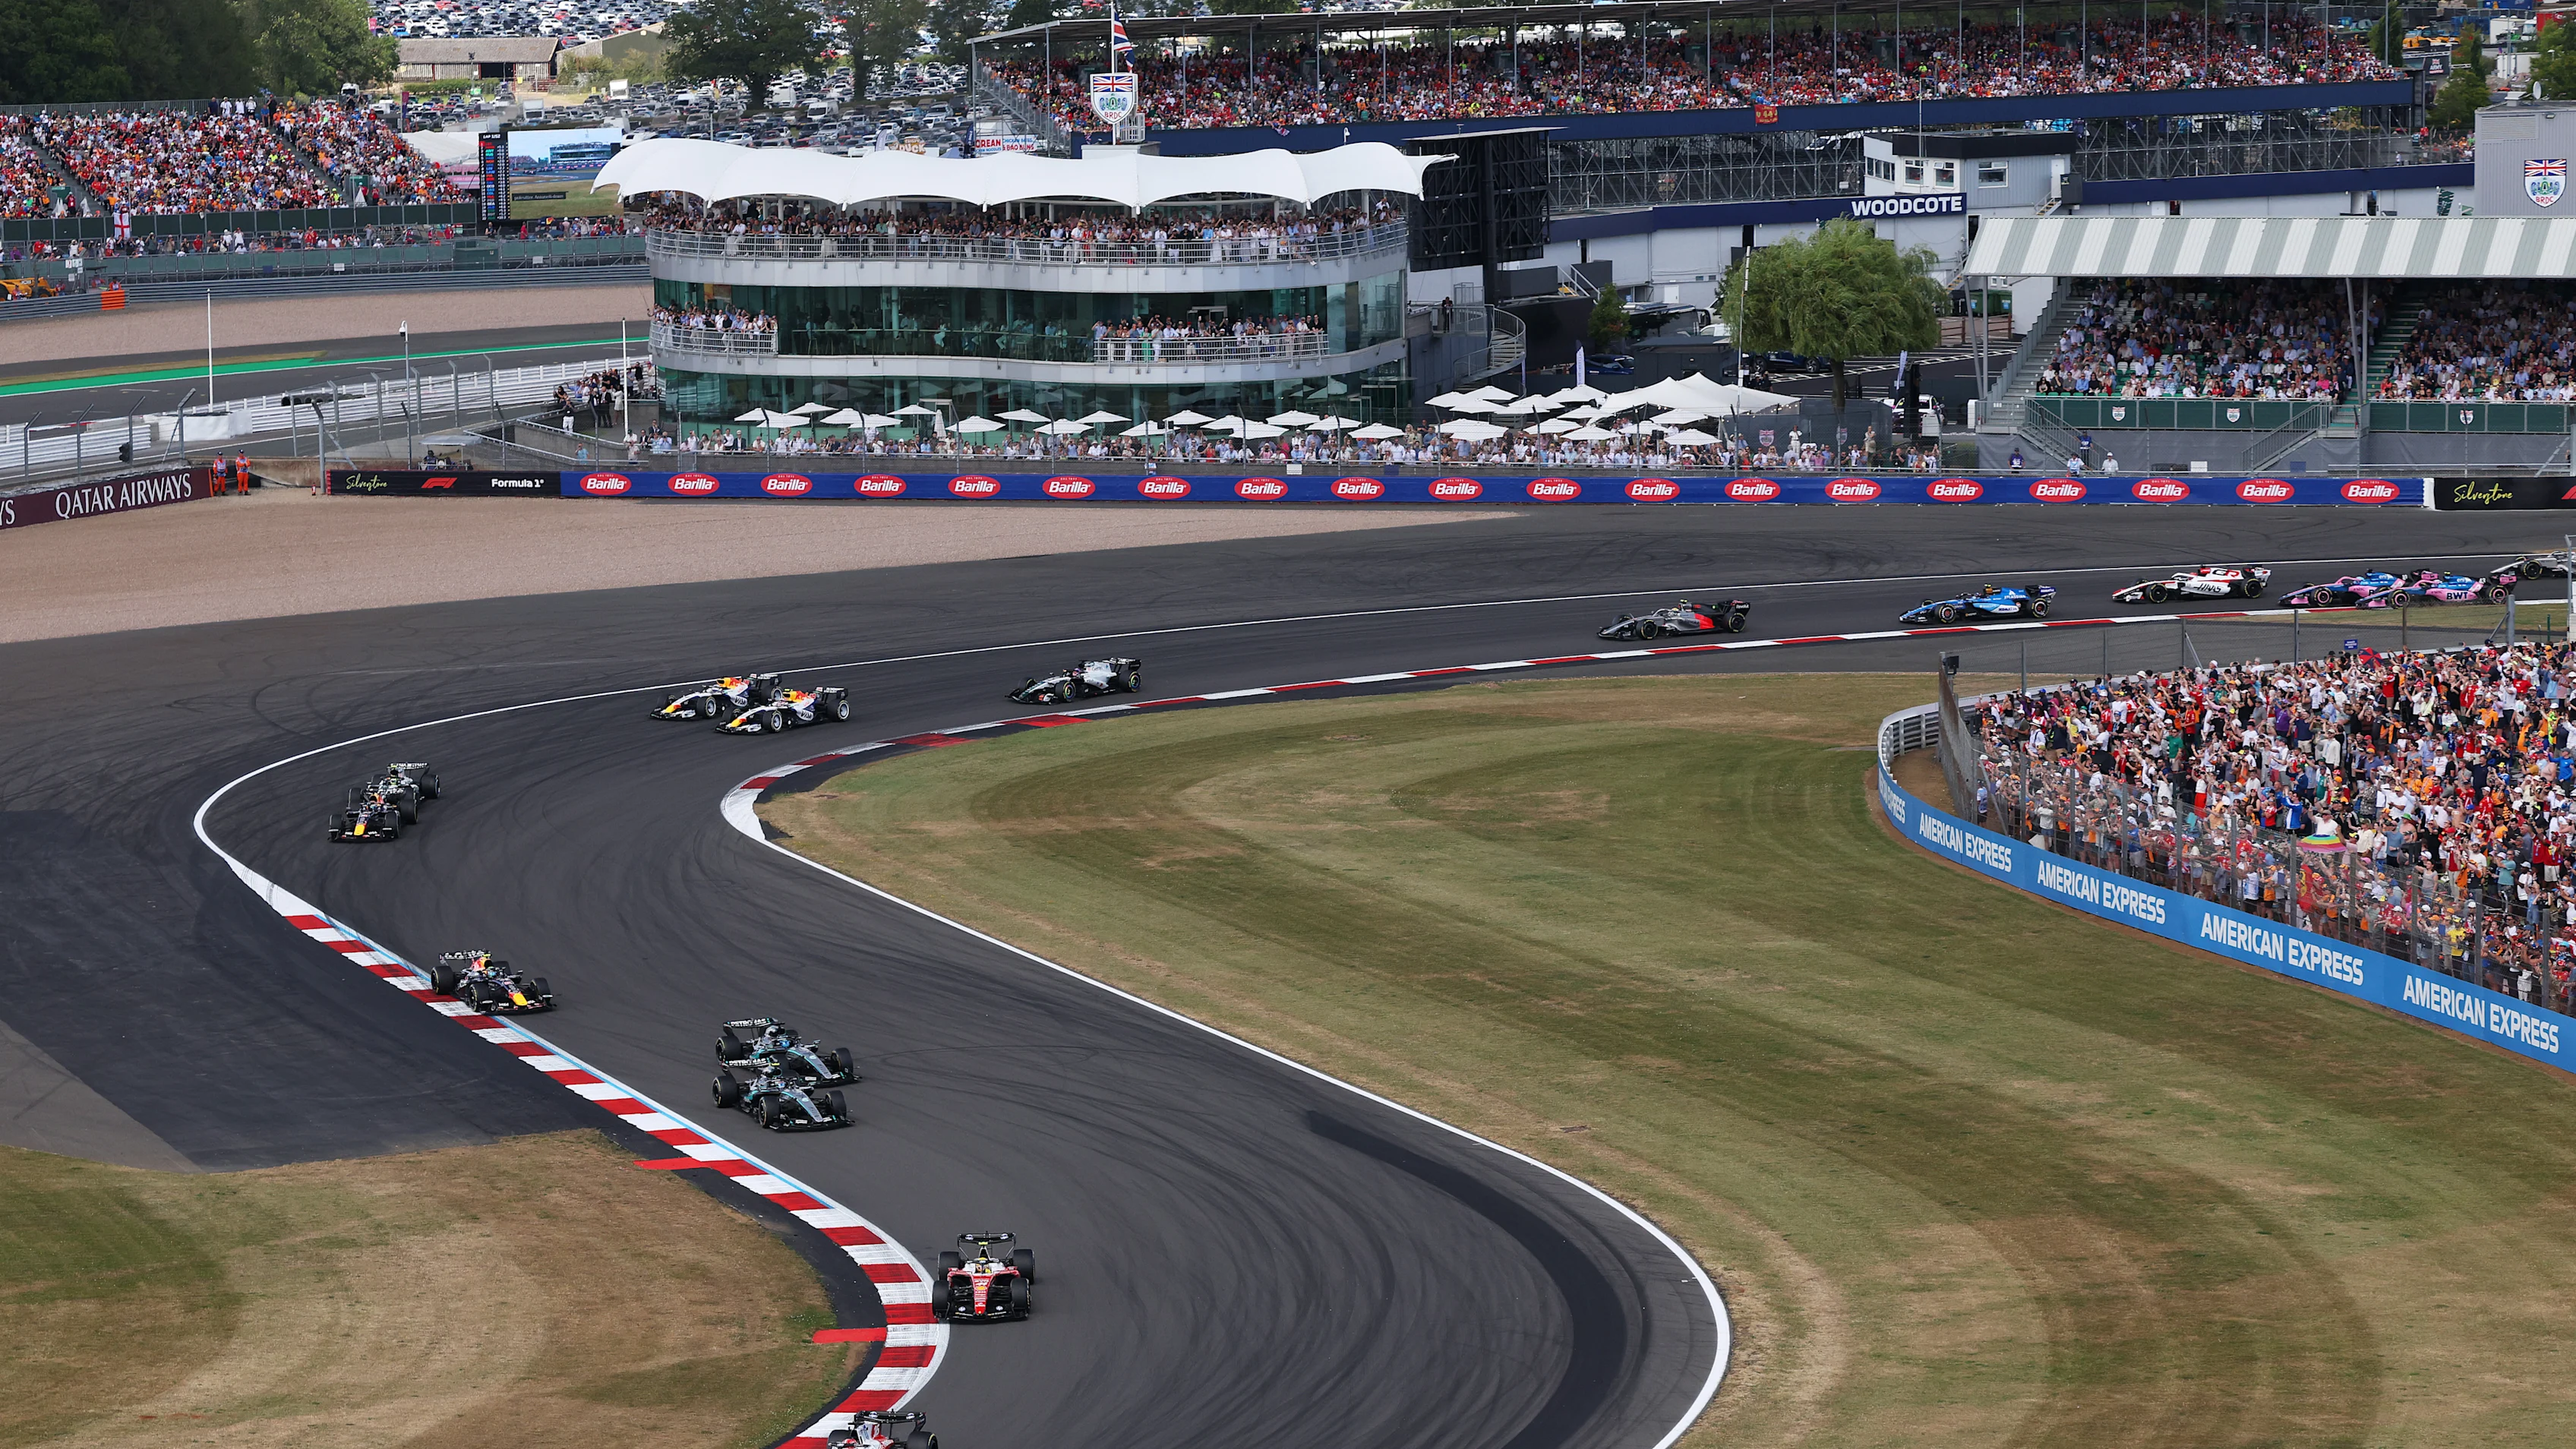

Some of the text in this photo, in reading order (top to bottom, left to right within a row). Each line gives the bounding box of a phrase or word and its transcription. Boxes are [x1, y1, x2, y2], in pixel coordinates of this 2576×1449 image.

[899, 143, 926, 153] DUCK
[975, 139, 1001, 148] OREAN
[1852, 196, 1962, 216] WOODCOTE
[346, 473, 388, 491] Silverstone
[491, 478, 532, 488] Formula
[586, 478, 625, 489] Barilla
[674, 478, 713, 489] Barilla
[767, 479, 806, 490] Barilla
[860, 480, 900, 491] Barilla
[955, 481, 994, 491] Barilla
[1049, 481, 1089, 492] Barilla
[1144, 482, 1184, 493] Barilla
[1241, 483, 1281, 494] Barilla
[1337, 483, 1378, 494] Barilla
[1435, 484, 1476, 494] Barilla
[1533, 484, 1574, 494] Barilla
[1631, 485, 1673, 495] Barilla
[1732, 485, 1773, 495] Barilla
[1832, 485, 1874, 495] Barilla
[1934, 485, 1976, 495] Barilla
[2036, 485, 2079, 495] Barilla
[2139, 485, 2183, 495] Barilla
[2243, 485, 2287, 496] Barilla
[2347, 486, 2392, 497] Barilla
[2454, 481, 2513, 504] Silverstone
[55, 485, 115, 519] QATAR
[119, 472, 192, 508] AIRWAYS
[2446, 592, 2468, 600] BWT
[1919, 812, 2012, 873] AMERICAN EXPRESS
[2037, 860, 2165, 925] AMERICAN EXPRESS
[2201, 912, 2363, 986] AMERICAN EXPRESS
[2403, 974, 2559, 1053] AMERICAN EXPRESS
